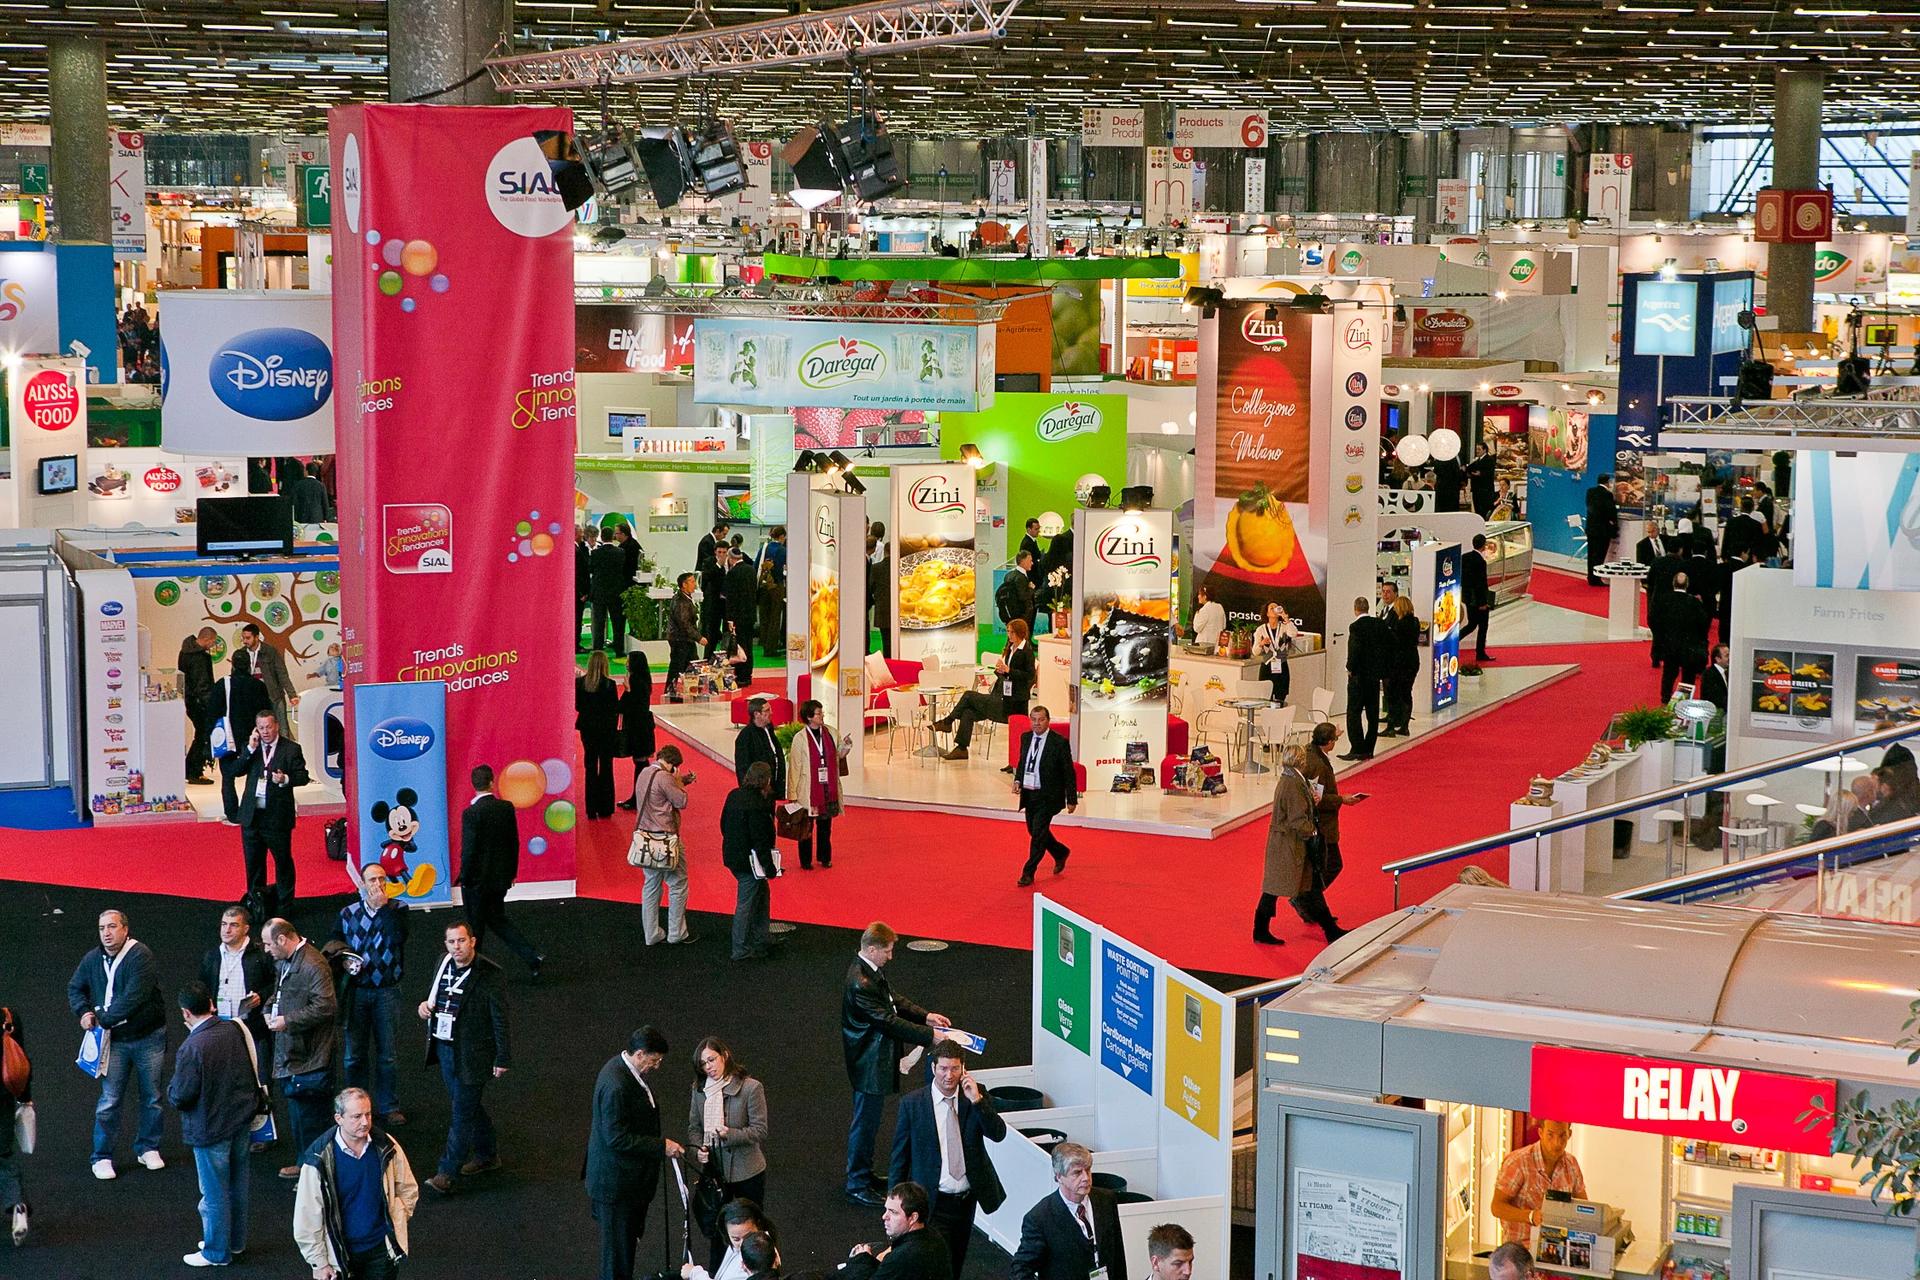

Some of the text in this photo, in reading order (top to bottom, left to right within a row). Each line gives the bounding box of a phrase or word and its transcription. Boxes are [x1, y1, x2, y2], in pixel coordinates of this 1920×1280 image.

[1179, 116, 1224, 127] Products
[130, 133, 141, 147] 6
[1241, 115, 1265, 148] 6
[118, 150, 138, 158] SIAL
[759, 144, 770, 157] 6
[1182, 148, 1192, 159] 6
[1622, 155, 1632, 167] 6
[1344, 255, 1359, 265] ardo
[1512, 262, 1532, 276] ardo
[1642, 300, 1681, 311] Argentina
[1248, 318, 1284, 337] Zini
[1349, 327, 1371, 343] Zini
[631, 348, 667, 368] Food
[27, 382, 75, 402] ALYSSE
[852, 394, 870, 402] Tout
[881, 395, 903, 404] jardin
[910, 396, 935, 405] portée
[936, 396, 946, 404] de
[1230, 386, 1297, 427] Collezione
[34, 406, 72, 426] FOOD
[1618, 424, 1645, 433] Argentina
[1230, 430, 1284, 463] Milano
[597, 461, 636, 471] Aromatiques
[672, 463, 690, 471] Herbs
[697, 464, 719, 472] Herbes
[146, 471, 178, 482] ALYSSE
[150, 481, 177, 491] FOOD
[918, 487, 961, 505] Zini
[397, 524, 422, 536] Trends
[818, 515, 835, 540] Zini
[402, 538, 445, 553] Tendances
[1106, 536, 1155, 556] Zini
[423, 557, 450, 567] SIAL
[1812, 605, 1887, 622] Farm Frites
[413, 642, 464, 665] Trends
[413, 649, 519, 682] innovations
[1106, 947, 1149, 979] WASTE SORTING
[1116, 963, 1140, 984] POINT TRI
[1057, 997, 1074, 1016] Glass
[1058, 1011, 1073, 1028] Verre
[1102, 1021, 1153, 1061] Cardboard, paper
[1105, 1037, 1149, 1073] Cartons, papiers
[1182, 1074, 1202, 1095] Other
[1182, 1090, 1202, 1111] Autres
[1623, 1066, 1742, 1123] RELAY
[1299, 1201, 1333, 1210] LE FIGARO
